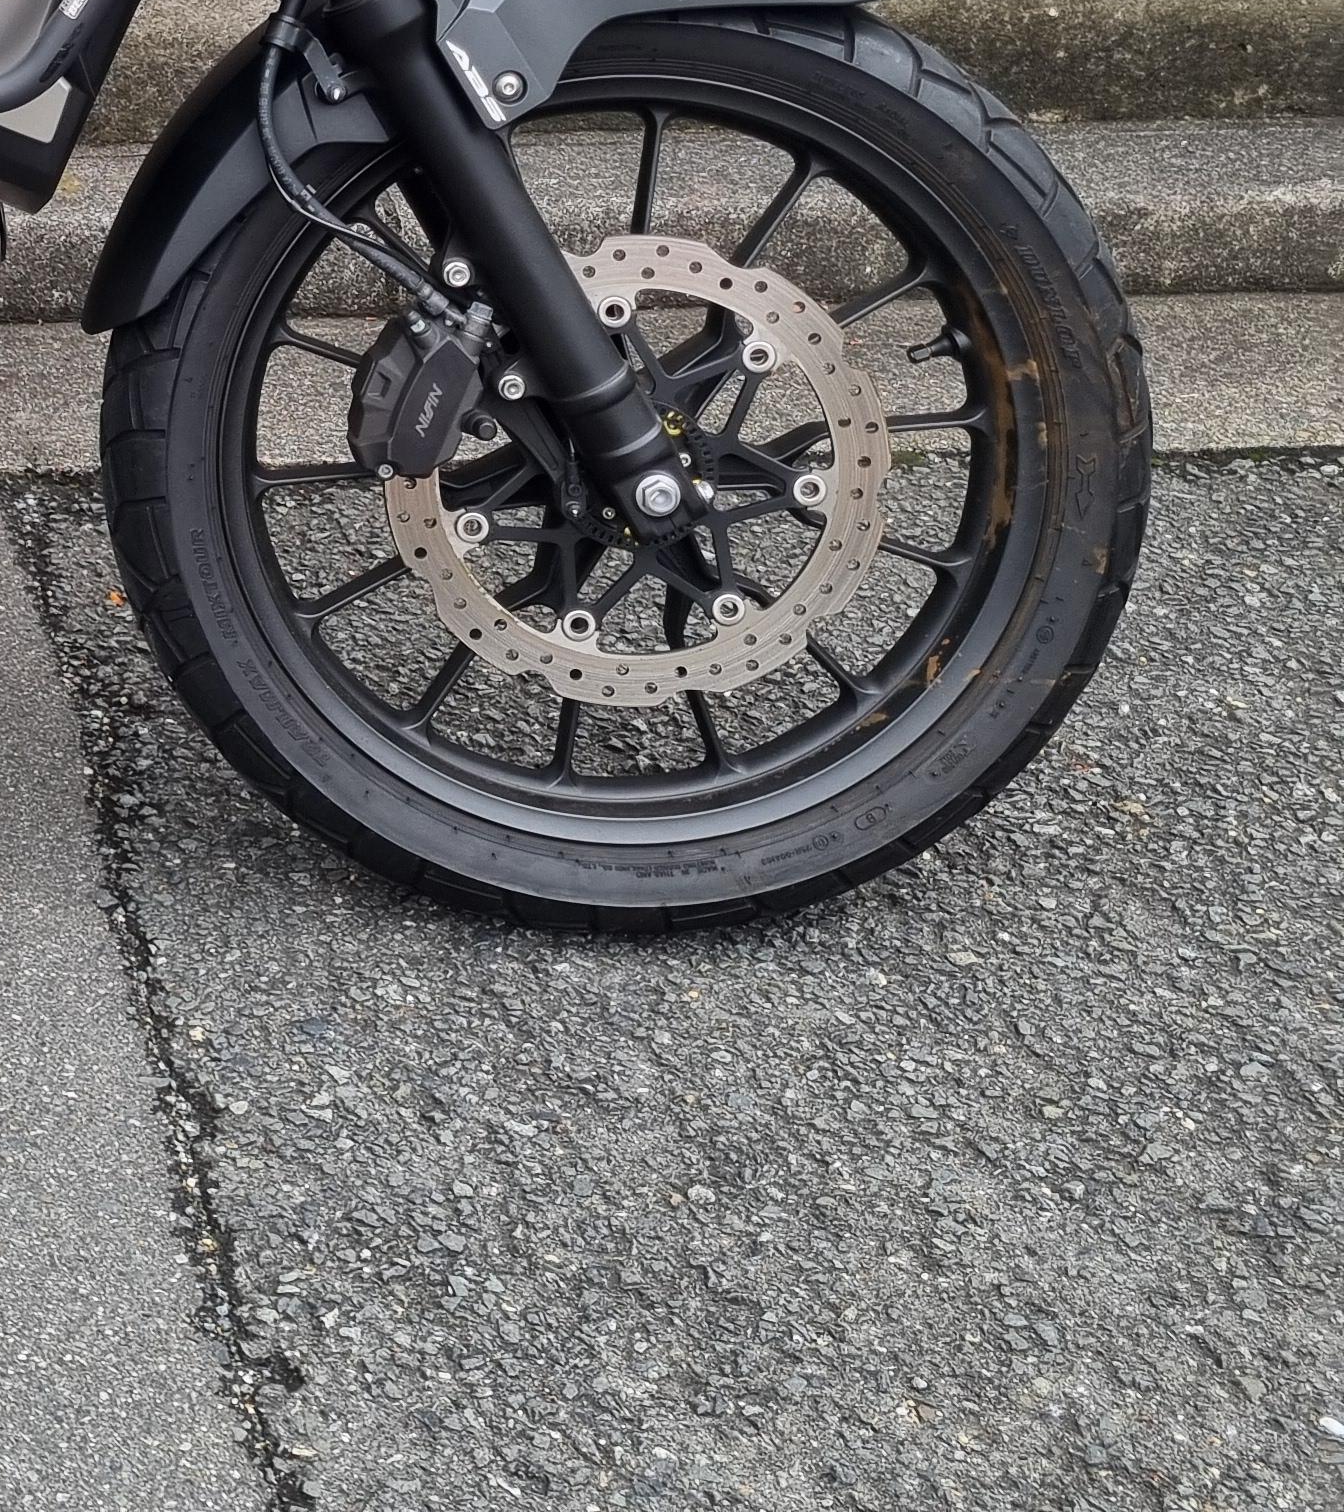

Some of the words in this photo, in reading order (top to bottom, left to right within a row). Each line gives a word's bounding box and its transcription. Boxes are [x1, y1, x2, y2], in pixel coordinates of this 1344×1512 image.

[445, 39, 507, 122] ABS
[1014, 245, 1082, 368] DUNLOP
[415, 382, 443, 438] NISSIN
